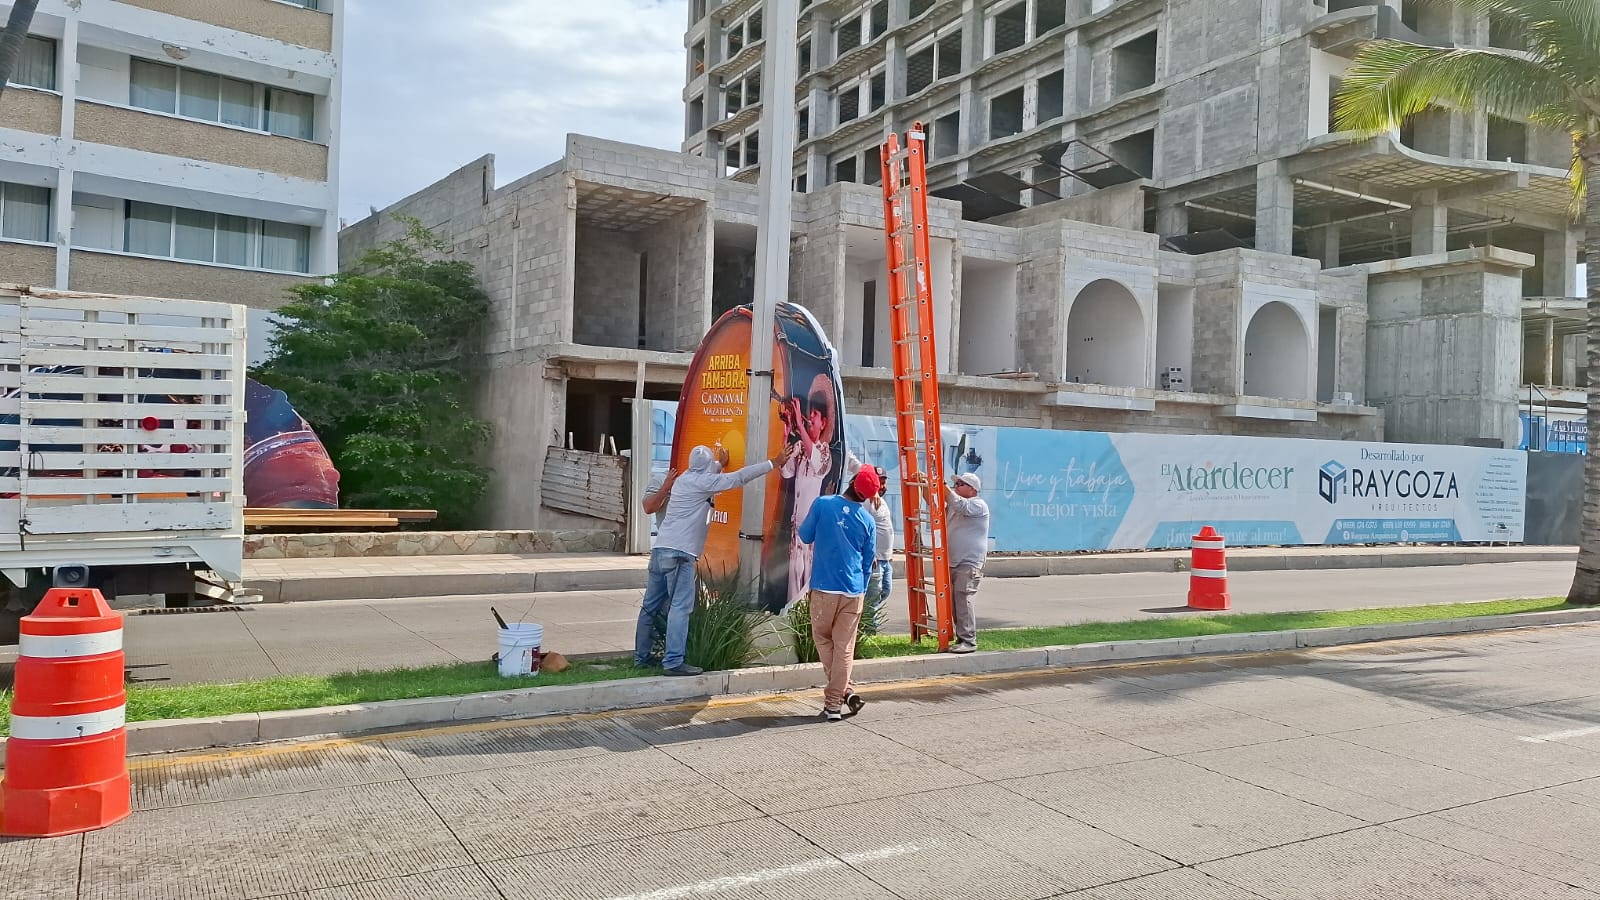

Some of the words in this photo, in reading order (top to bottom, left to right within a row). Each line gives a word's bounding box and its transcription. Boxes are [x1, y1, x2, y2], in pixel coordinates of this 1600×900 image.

[709, 355, 740, 370] ARRIBA
[702, 371, 746, 389] TAMBORA
[701, 391, 745, 405] CARNAVAL
[1361, 448, 1410, 462] Desarrollado
[1411, 454, 1425, 464] por
[1003, 455, 1046, 499] Vive
[1047, 474, 1062, 503] y
[1059, 456, 1127, 503] trabaja
[1167, 461, 1295, 492] Atardecer
[1352, 468, 1459, 499] RAYGOZA
[1030, 502, 1078, 521] mejor
[1082, 498, 1118, 518] vista
